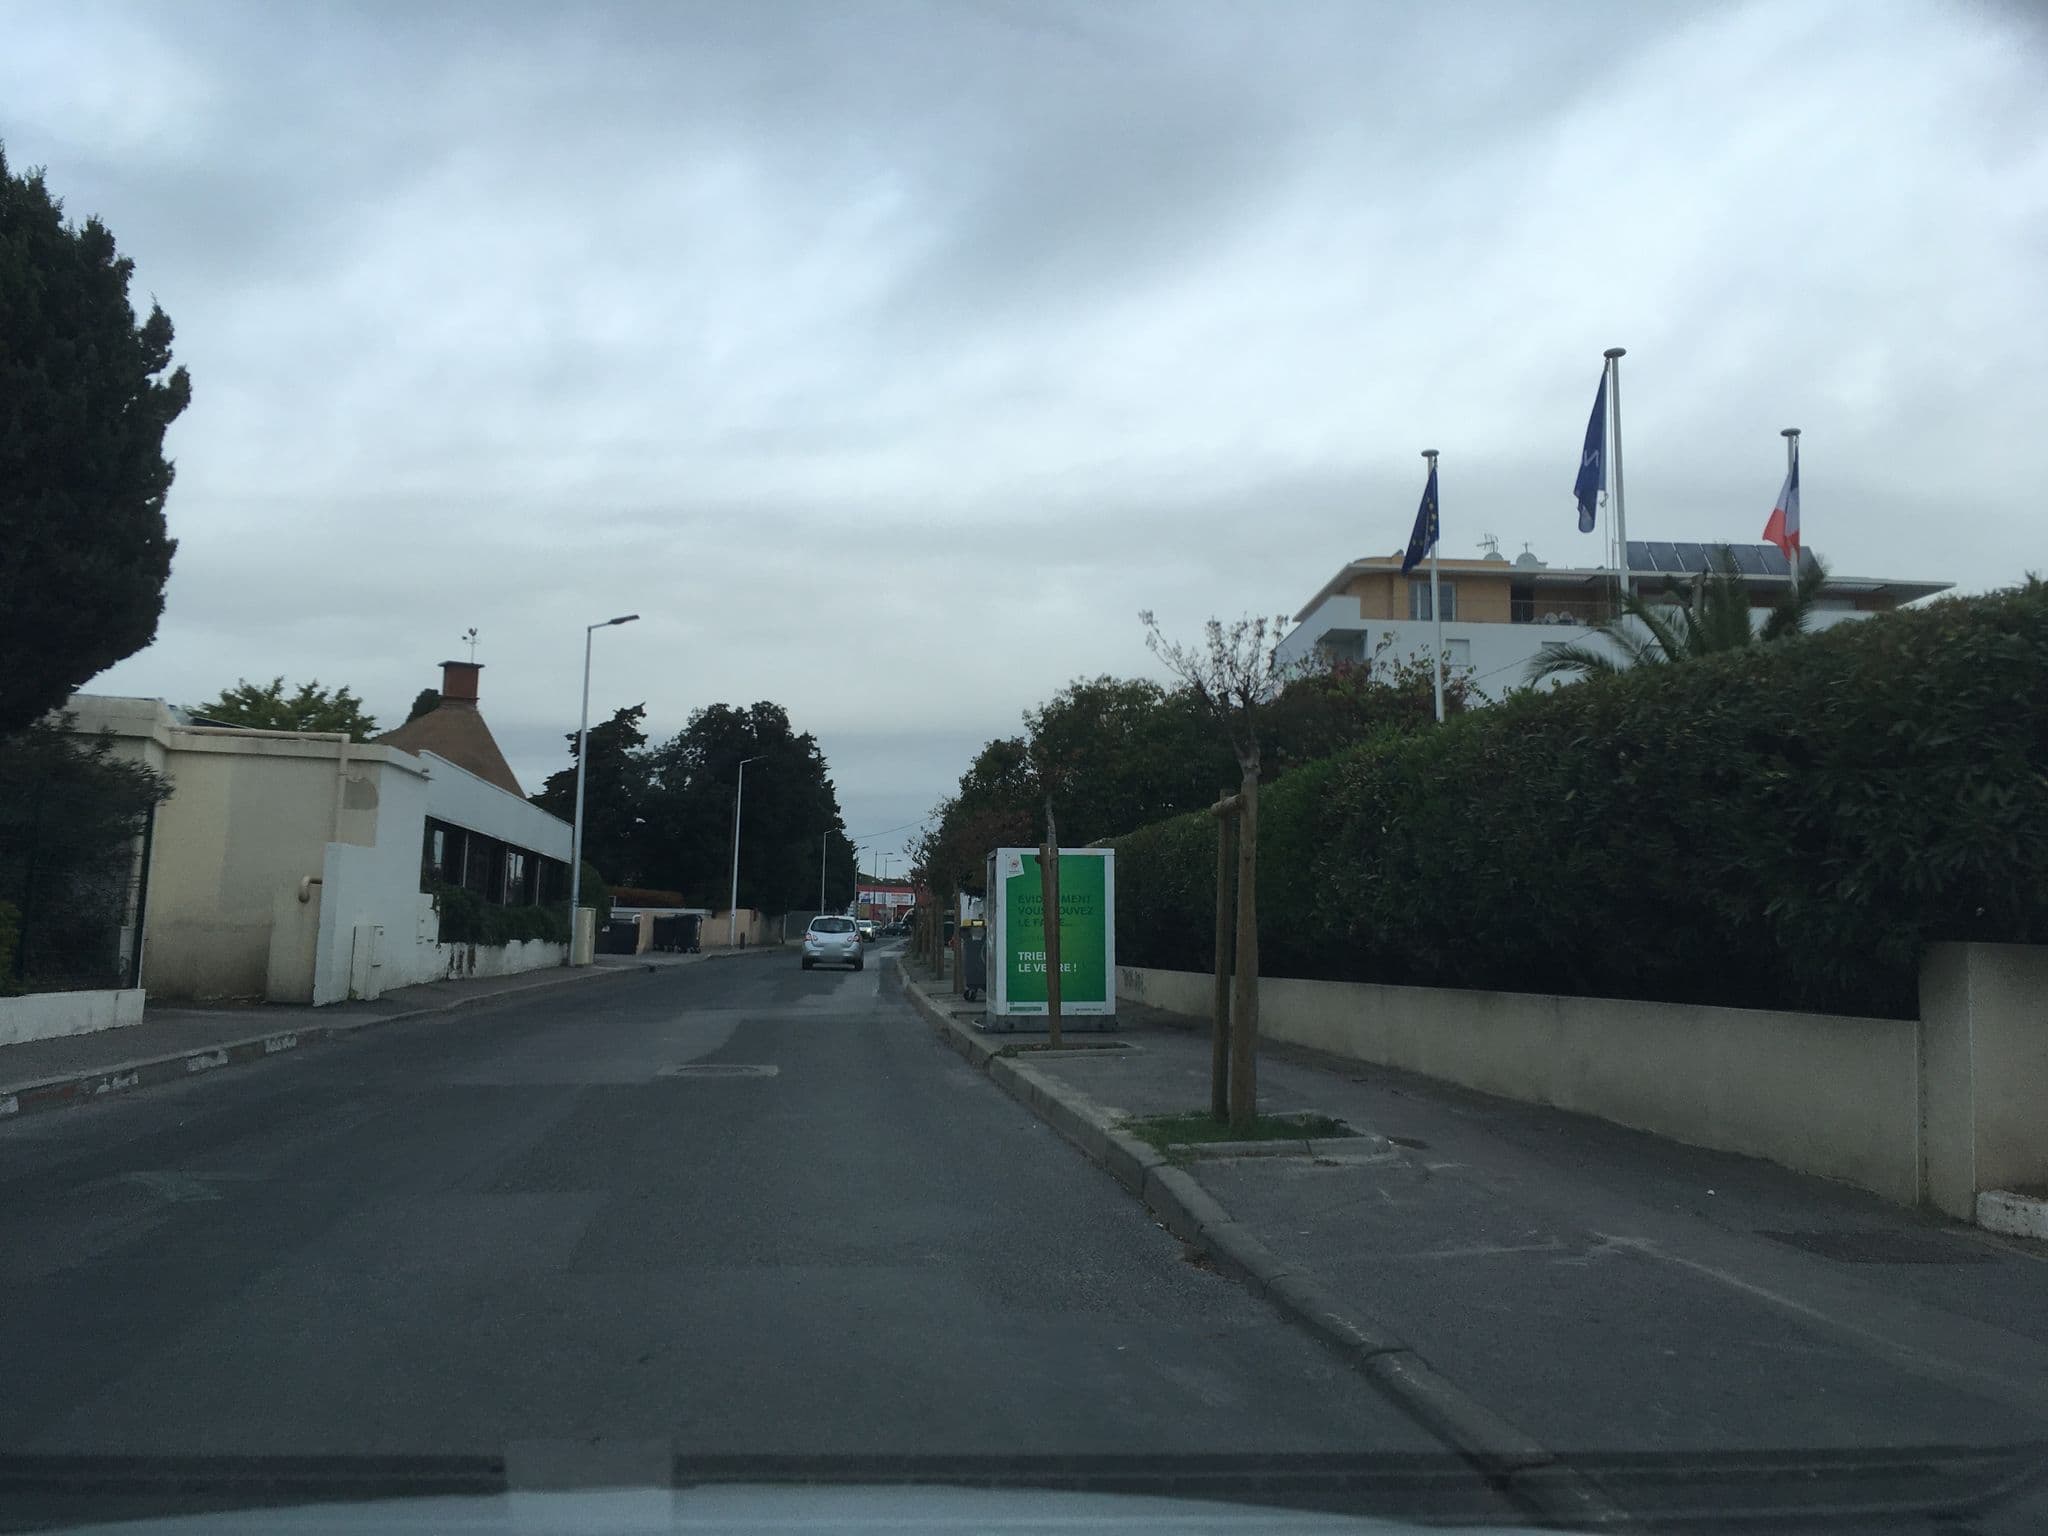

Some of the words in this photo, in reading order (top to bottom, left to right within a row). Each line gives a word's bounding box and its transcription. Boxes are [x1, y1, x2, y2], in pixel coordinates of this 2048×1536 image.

[1018, 895, 1090, 904] EVIDMENT
[1058, 906, 1094, 916] OUVEZ
[1018, 918, 1031, 928] LE
[1018, 963, 1032, 973] LE
[1033, 963, 1072, 973] VERE
